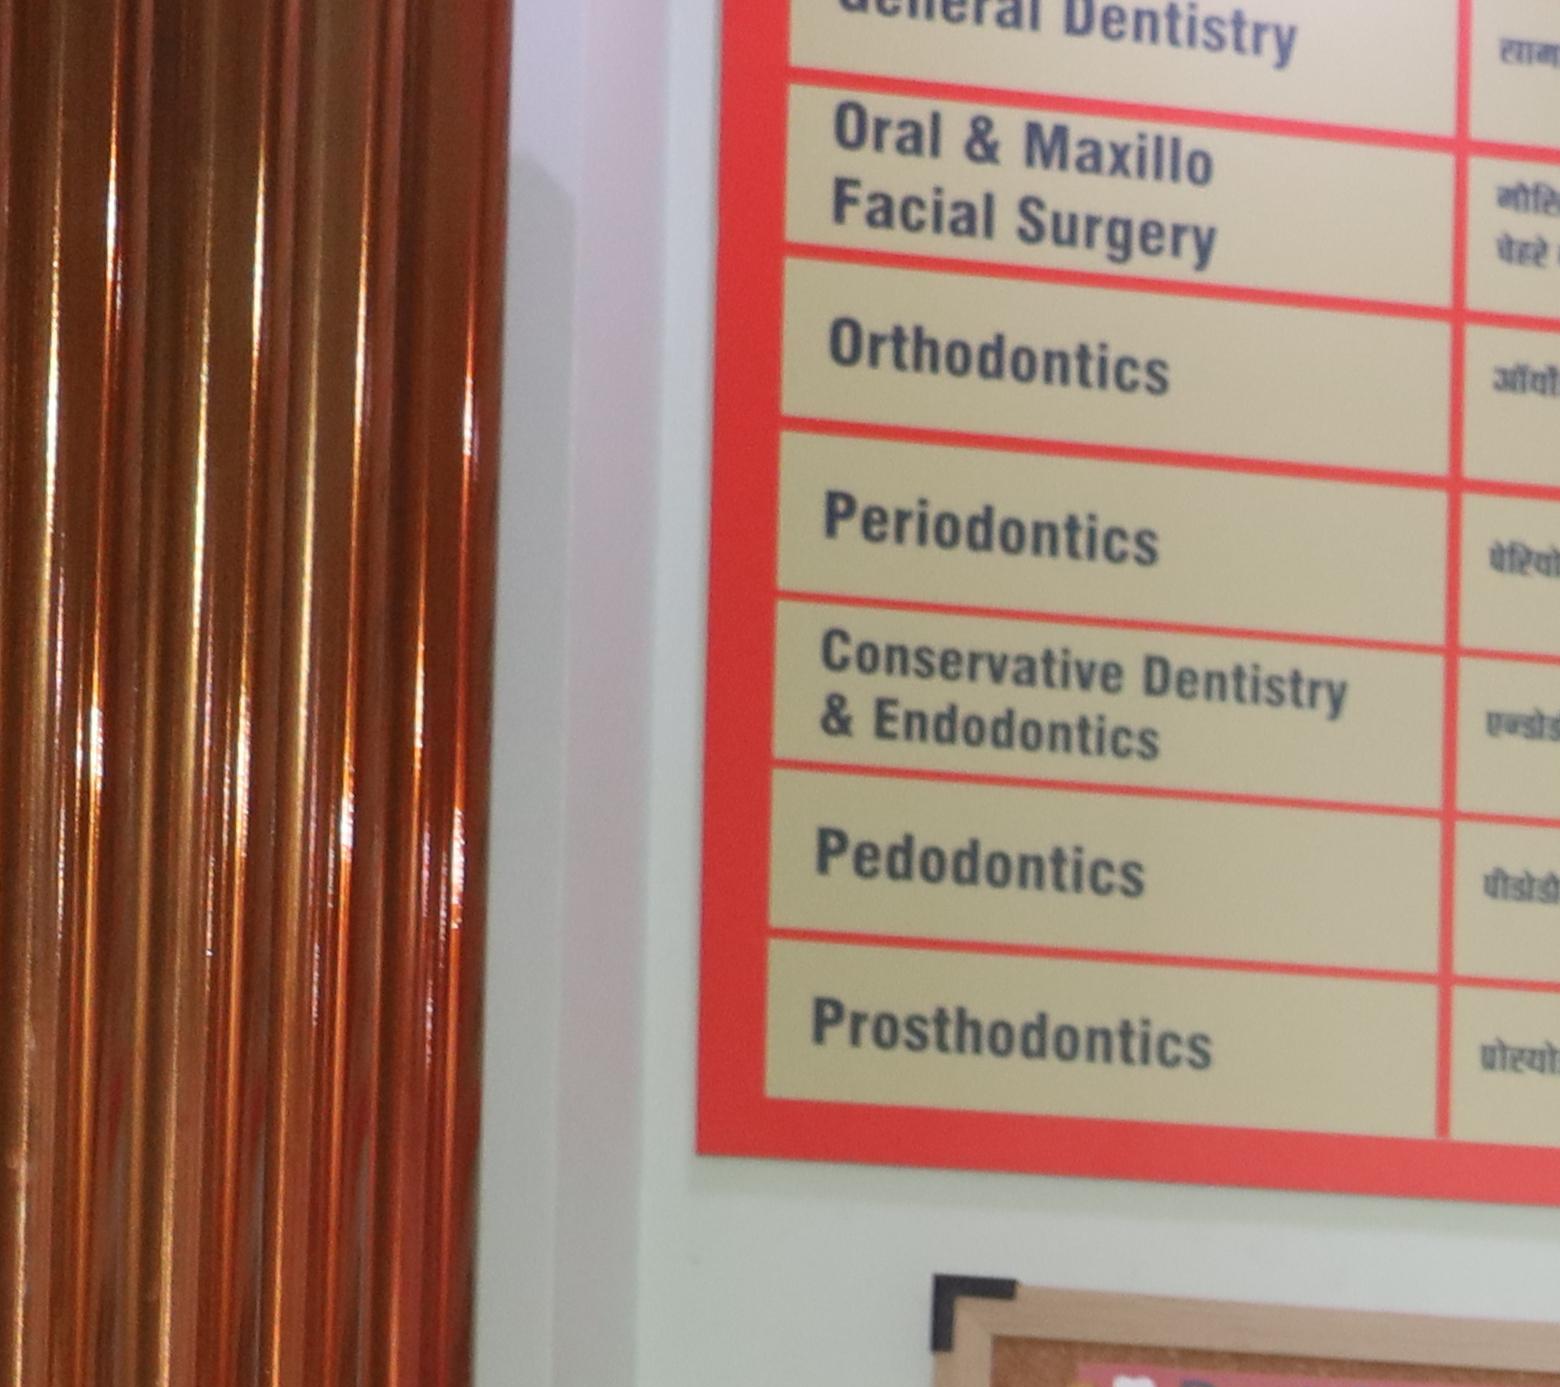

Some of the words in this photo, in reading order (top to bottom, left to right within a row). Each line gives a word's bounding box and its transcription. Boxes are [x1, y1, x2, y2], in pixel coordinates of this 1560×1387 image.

[1063, 0, 1300, 70] Dentistry
[833, 100, 943, 160] Oral
[963, 114, 1002, 164] &
[1022, 118, 1215, 188] Maxillo
[831, 176, 996, 240] Facial
[1016, 198, 1219, 270] Surgery
[828, 317, 1171, 398] Orthodontics
[822, 488, 1161, 569] Periodontics
[820, 628, 1126, 699] Conservative
[1141, 654, 1348, 721] Dentistry
[819, 693, 853, 737] &
[874, 698, 1160, 762] Endodontics
[813, 826, 1146, 901] Pedodontics
[810, 996, 1213, 1072] Prosthodontics
